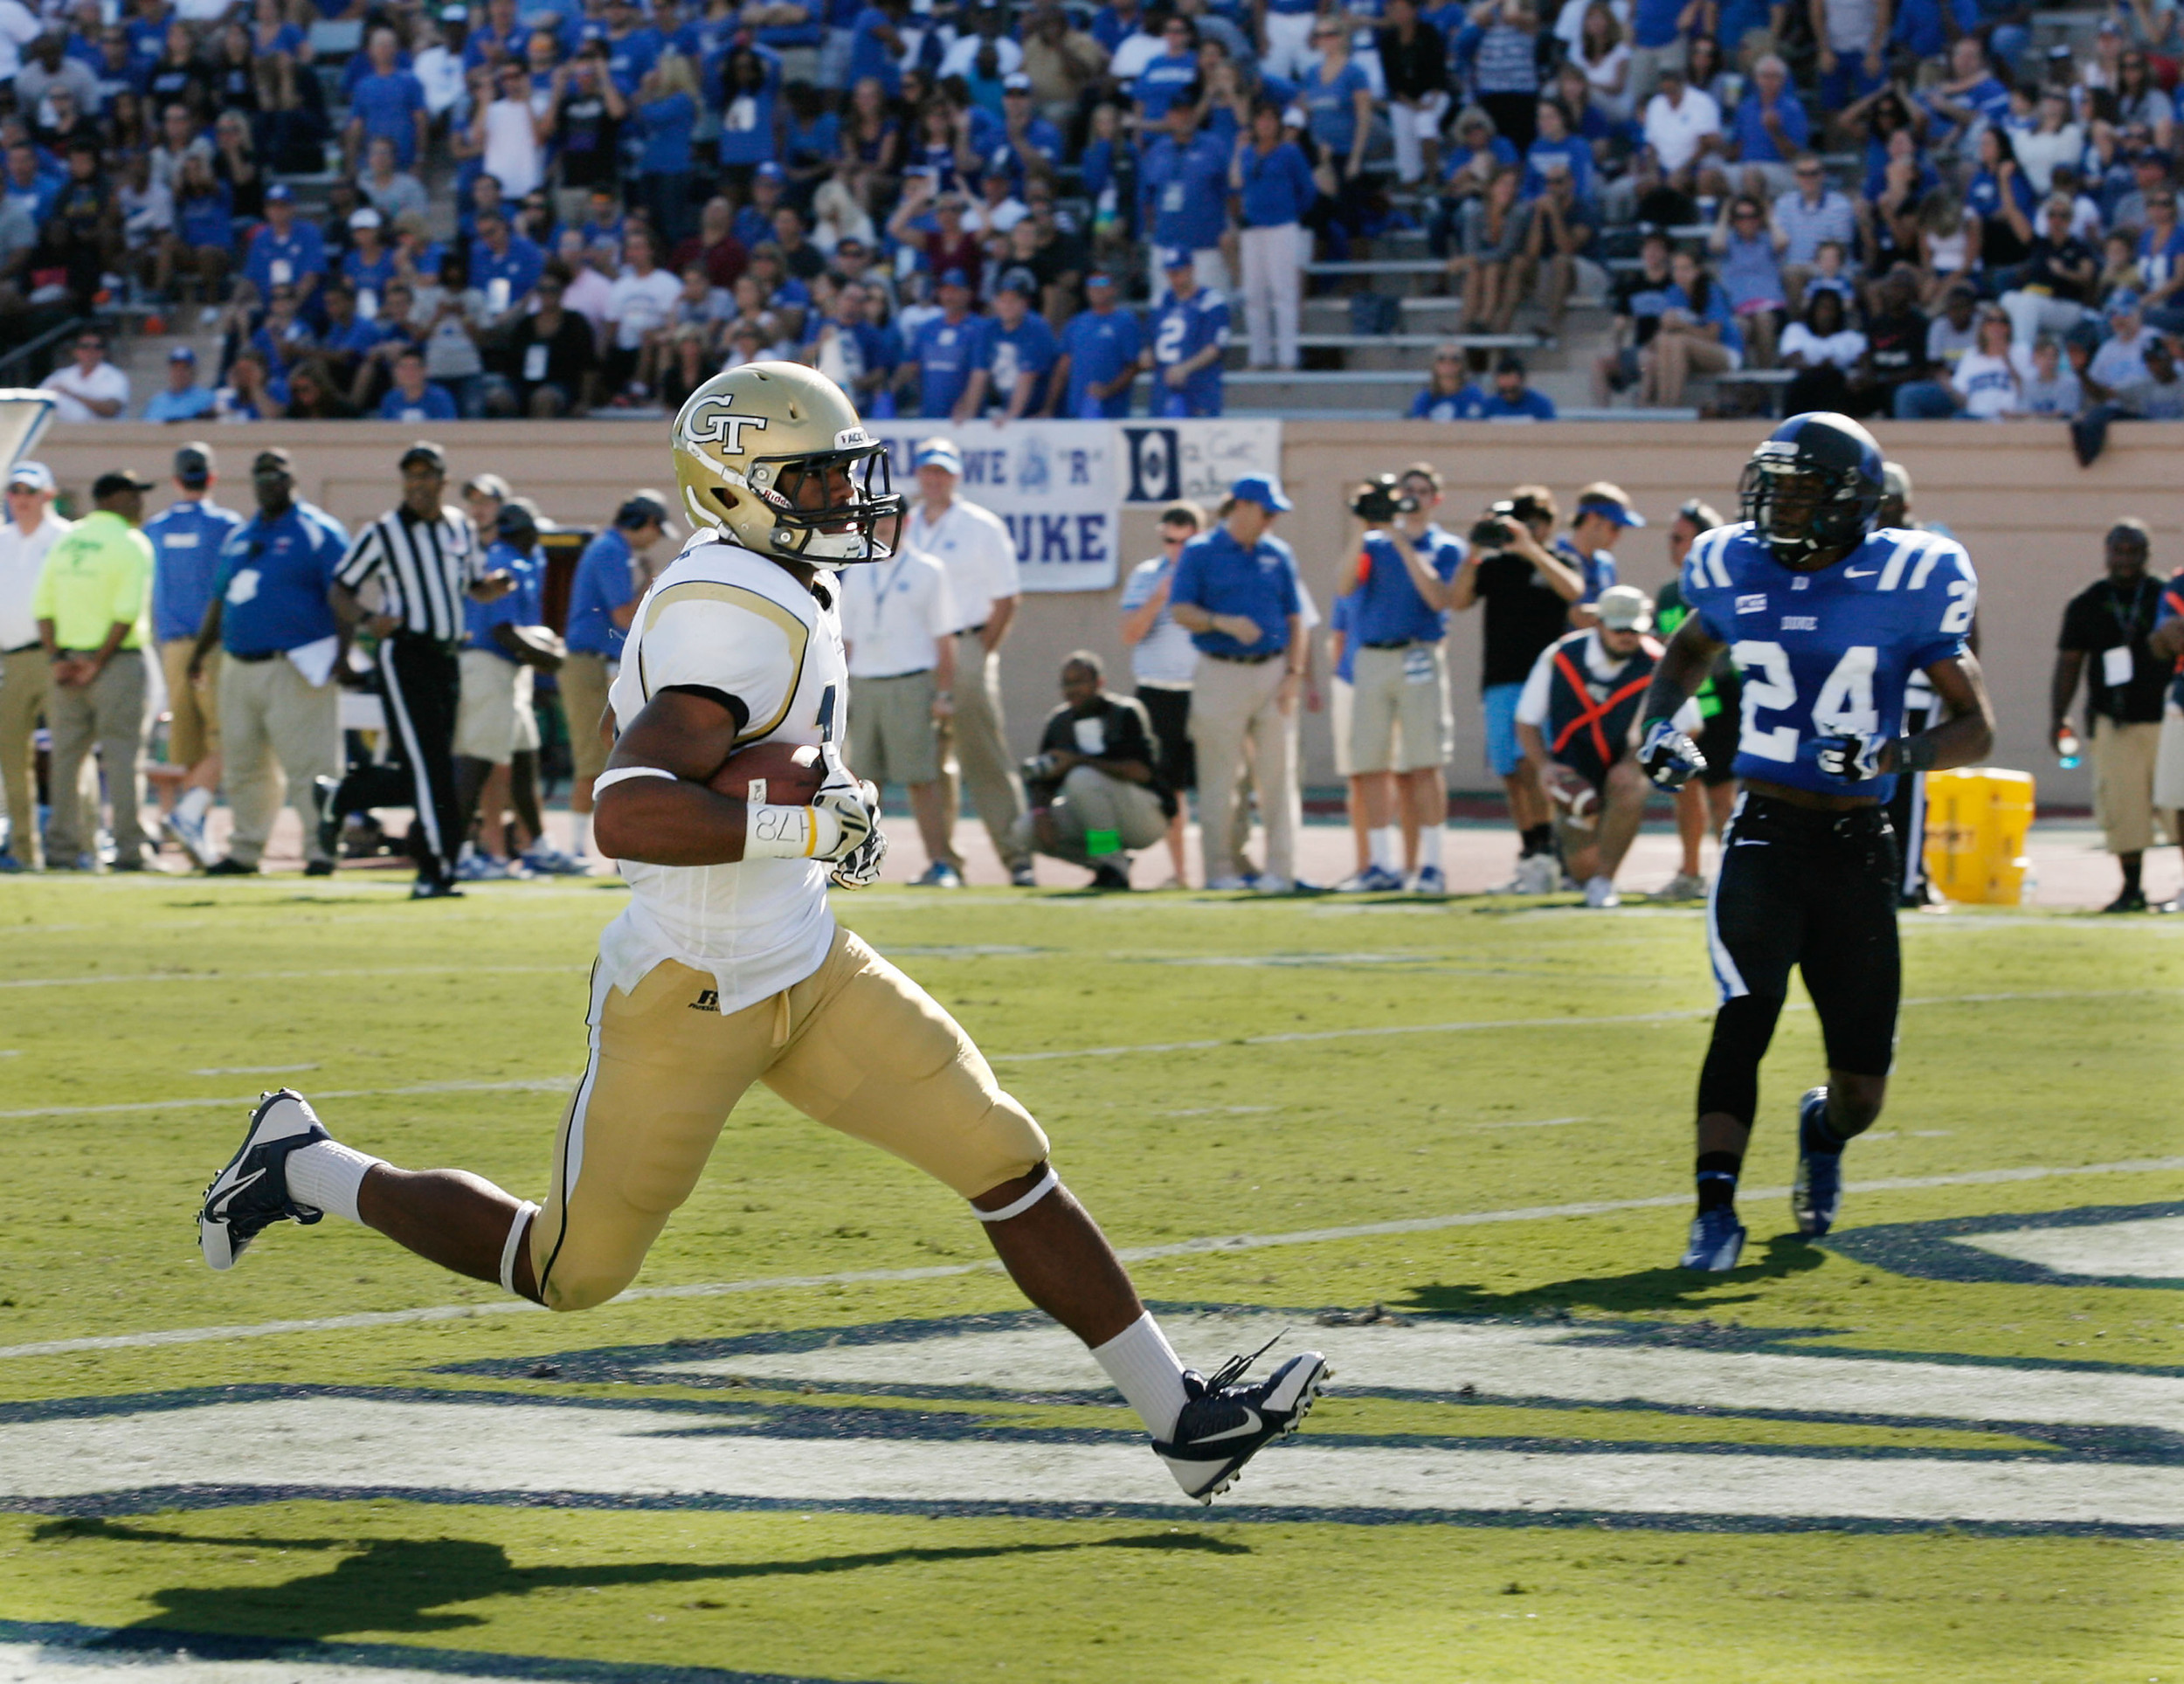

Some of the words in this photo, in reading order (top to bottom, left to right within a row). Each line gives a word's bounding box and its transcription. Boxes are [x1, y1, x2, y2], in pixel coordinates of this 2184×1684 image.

[1156, 315, 1186, 363] 2
[683, 393, 768, 455] GT
[961, 450, 1007, 483] WE
[1005, 513, 1108, 562] UKE
[1729, 639, 1879, 763] 24
